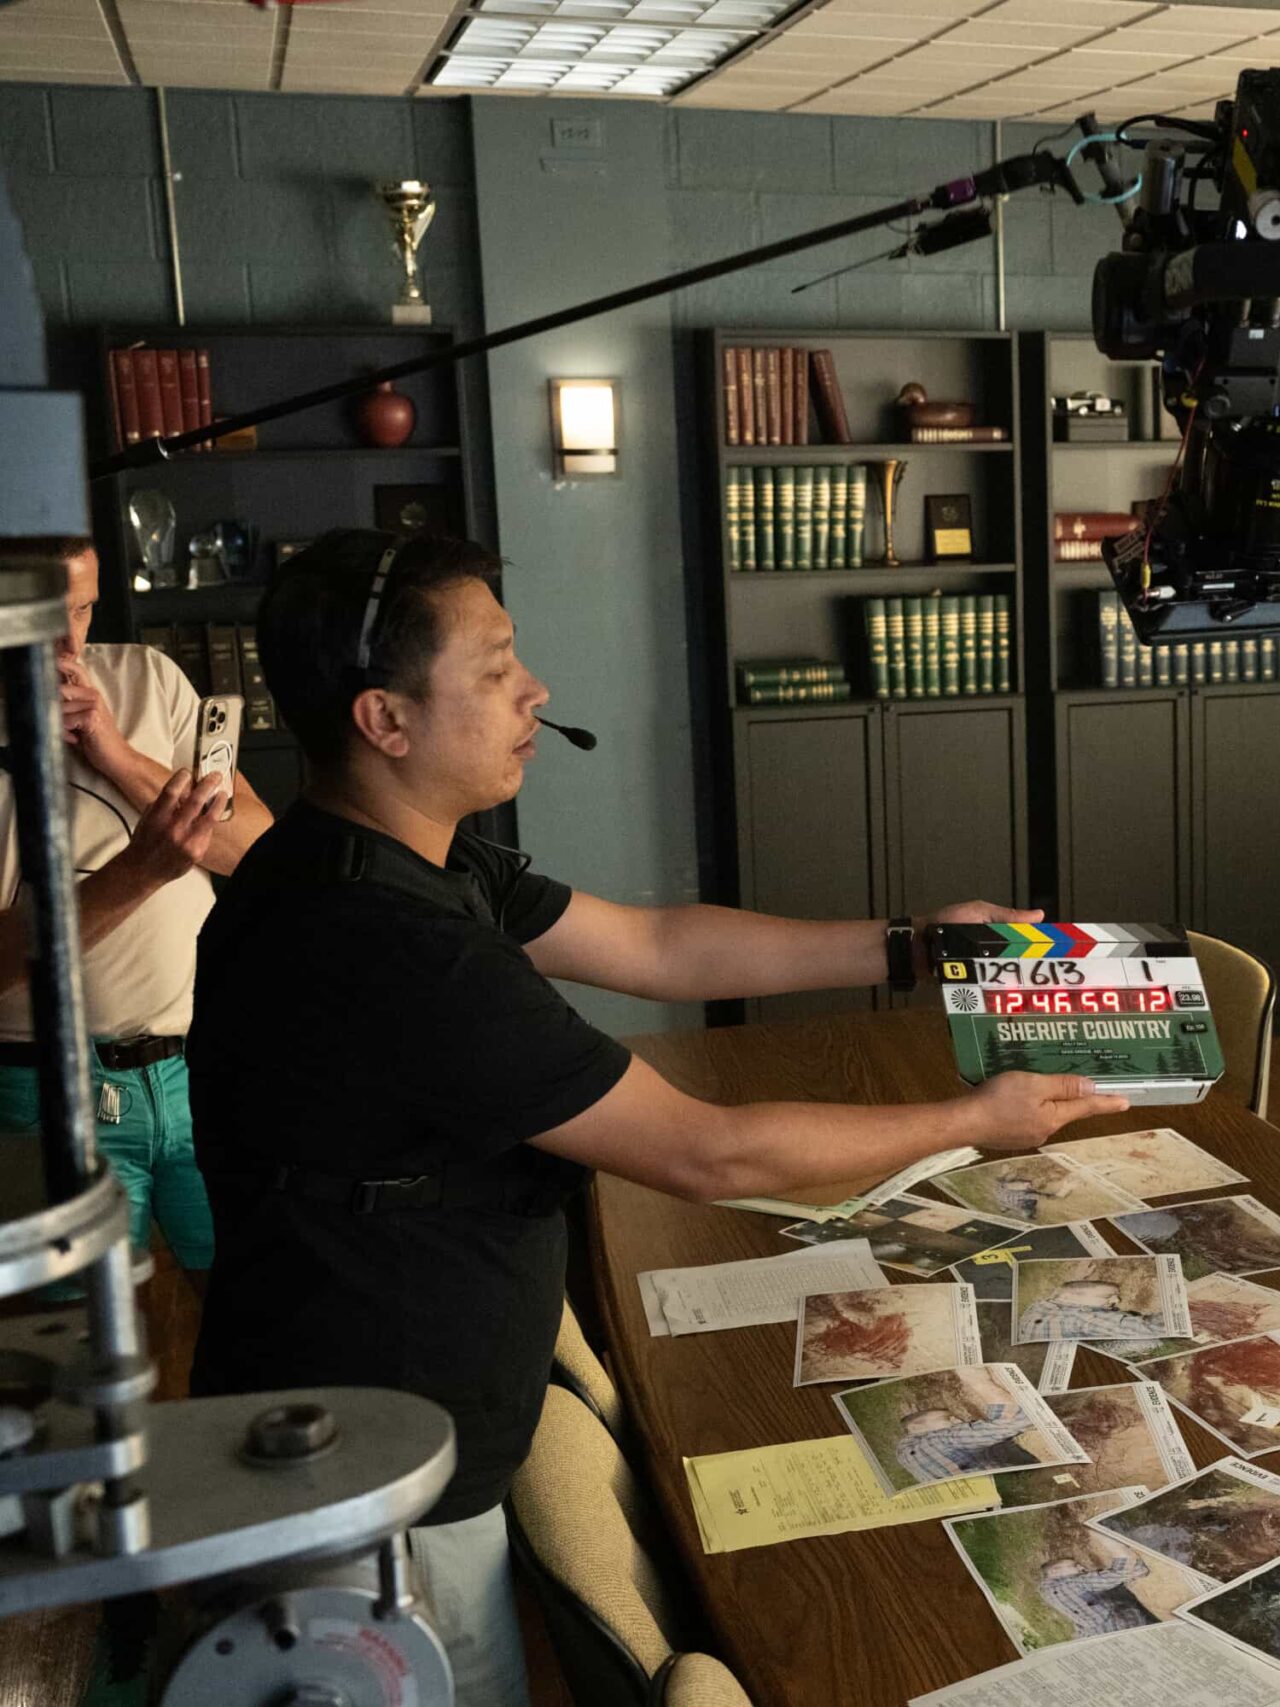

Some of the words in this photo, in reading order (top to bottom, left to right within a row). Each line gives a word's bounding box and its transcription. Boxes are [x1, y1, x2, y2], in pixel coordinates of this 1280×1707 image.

[949, 964, 960, 976] C
[979, 961, 1022, 985] 129
[1030, 960, 1085, 985] 613
[1141, 960, 1153, 981] 1
[995, 992, 1023, 1013] 12
[1032, 992, 1072, 1013] 46
[1081, 991, 1120, 1012] 59
[1139, 991, 1166, 1012] 12
[997, 1021, 1079, 1042] SHERIFF
[1083, 1020, 1171, 1040] COUNTY
[1146, 1386, 1161, 1407] EVIDENCE
[1229, 1462, 1269, 1480] EVIDENCE
